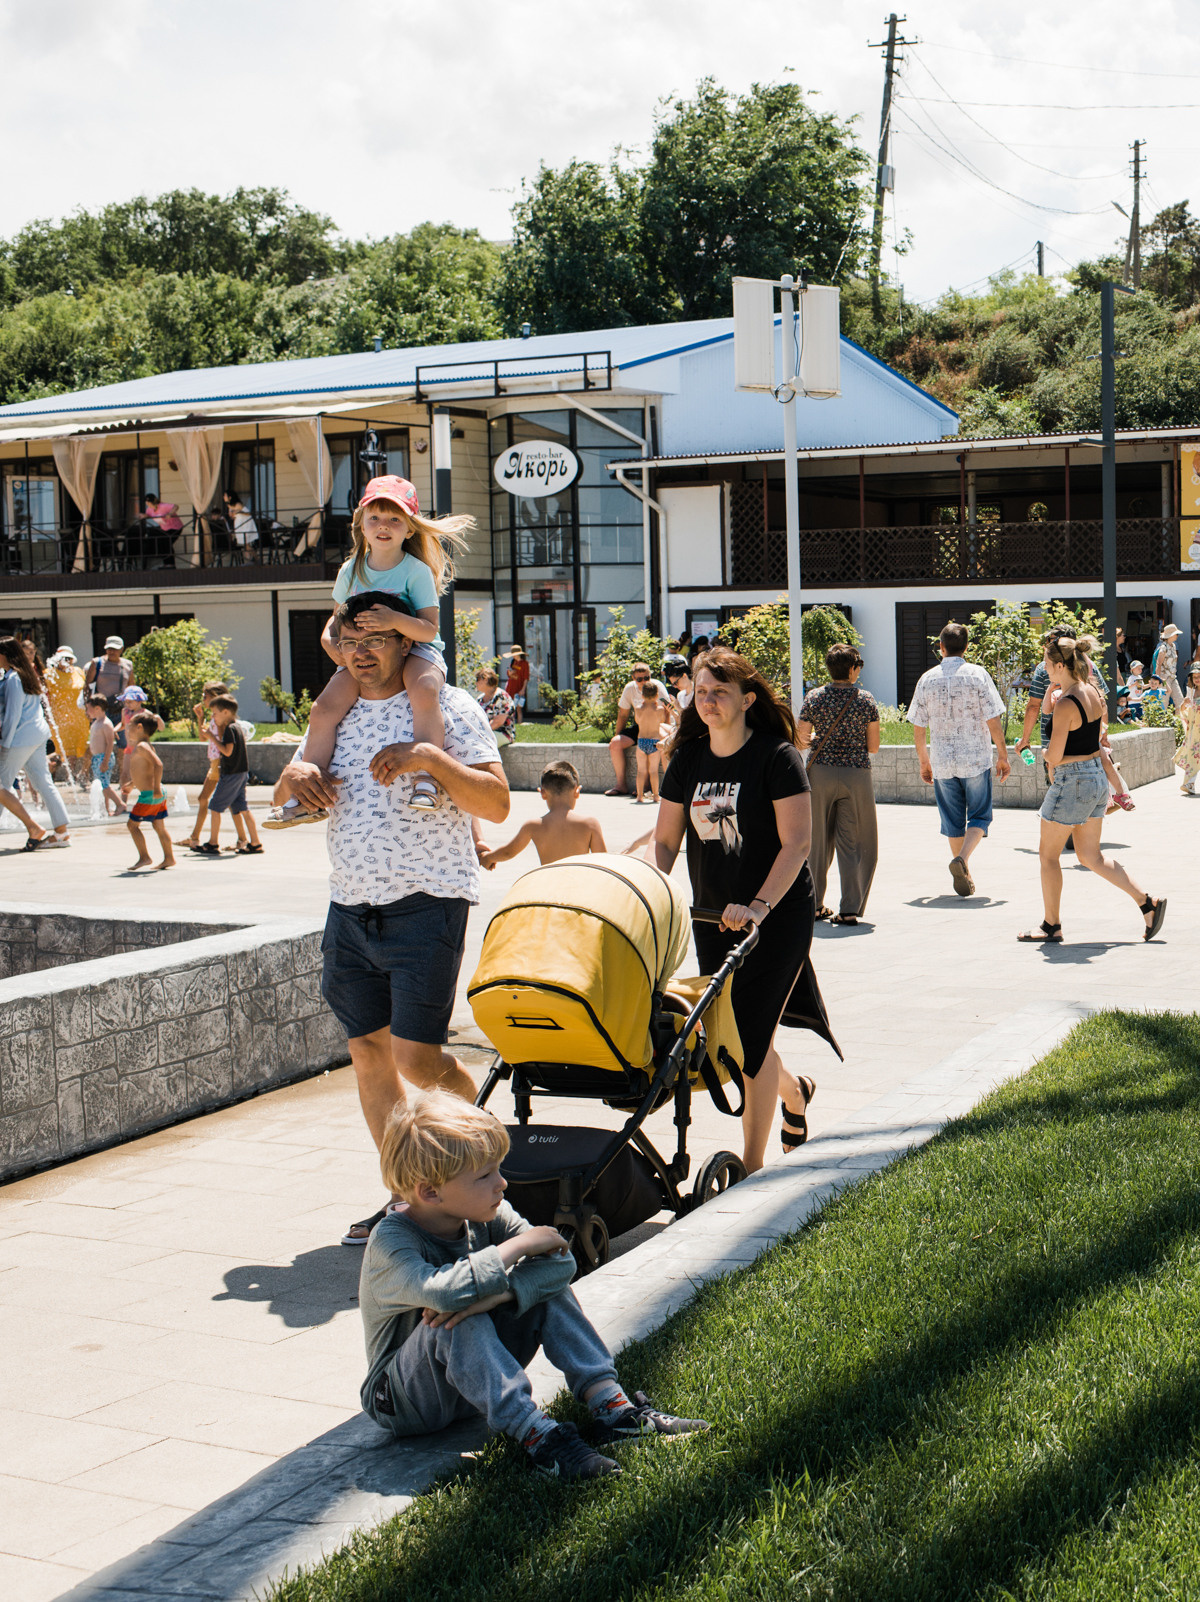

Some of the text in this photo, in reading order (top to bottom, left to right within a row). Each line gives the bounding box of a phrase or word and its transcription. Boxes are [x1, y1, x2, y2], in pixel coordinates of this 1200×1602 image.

[526, 448, 563, 460] resto-bar
[503, 451, 568, 486] Якорь
[698, 782, 737, 797] TIME
